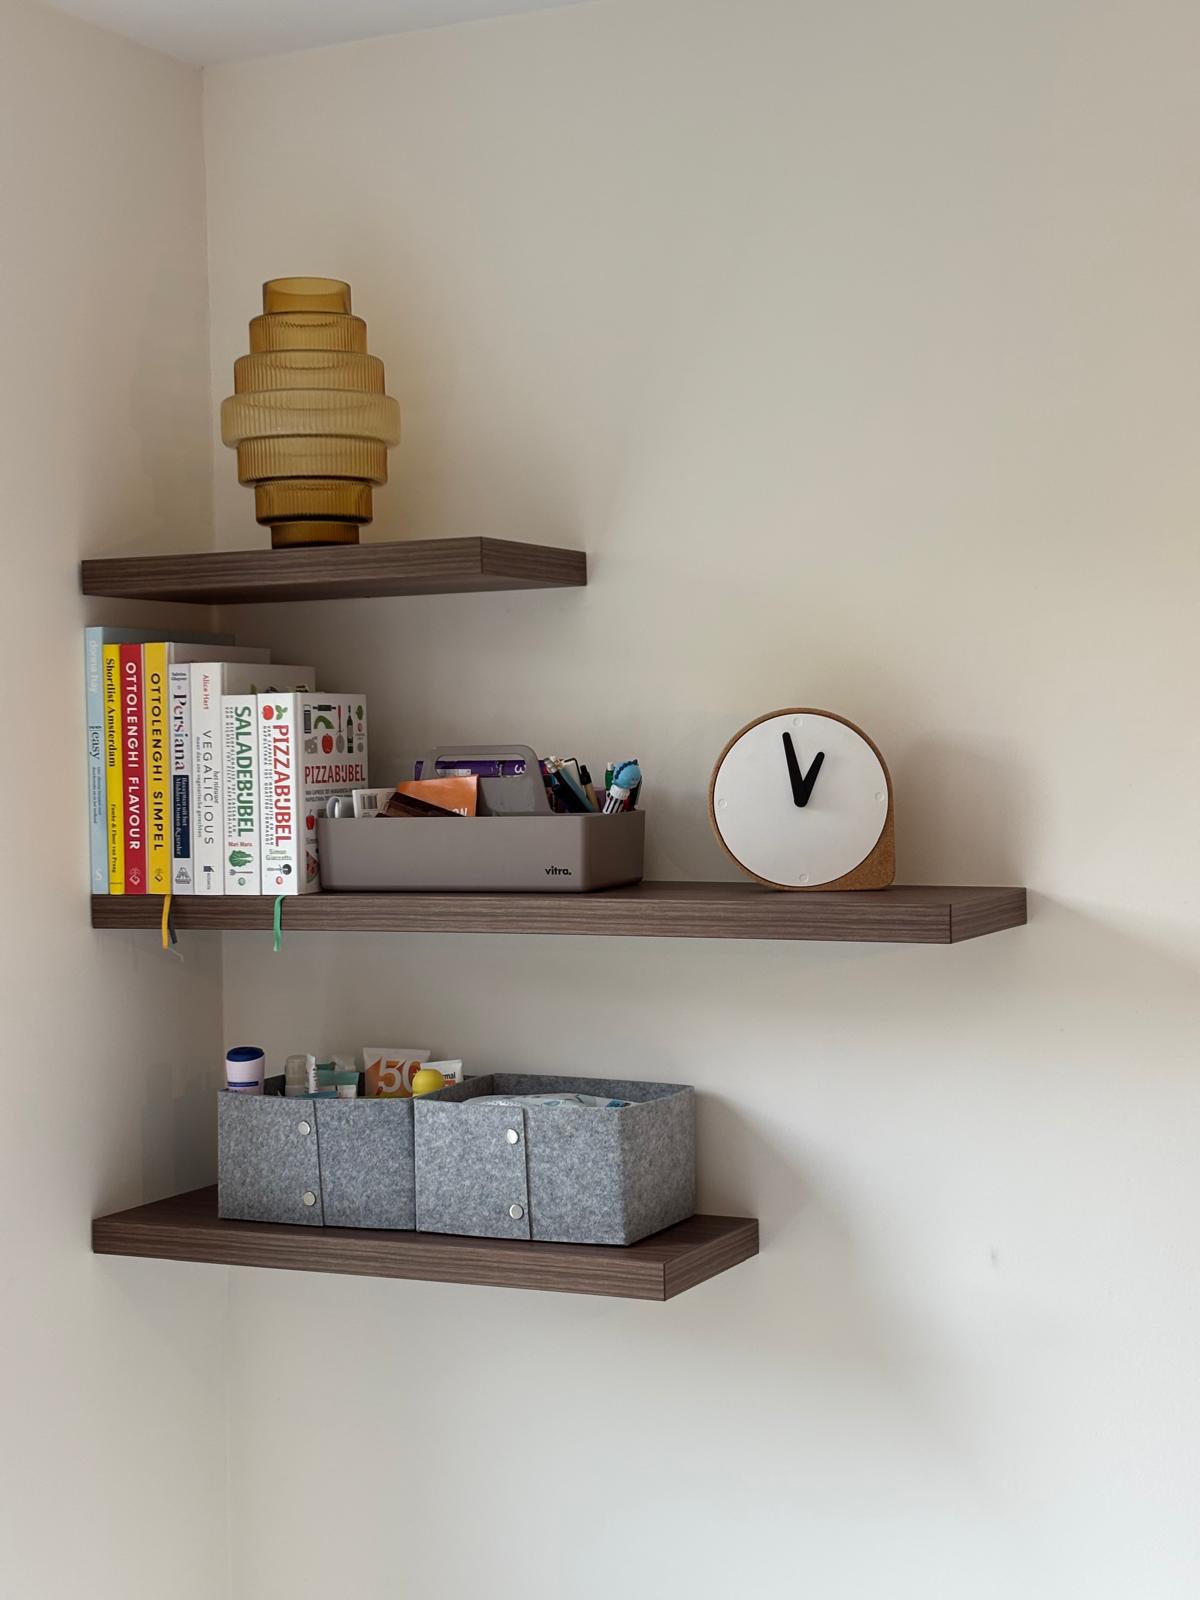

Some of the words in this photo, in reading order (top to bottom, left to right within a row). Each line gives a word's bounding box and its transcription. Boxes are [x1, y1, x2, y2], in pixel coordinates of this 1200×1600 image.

[88, 675, 98, 693] hay
[106, 658, 116, 703] Shortlist
[107, 706, 117, 767] Amsterdam
[126, 662, 139, 768] OTTOLENGHI
[151, 673, 163, 781] OTTOLENGHI
[173, 694, 188, 771] Persiana
[90, 732, 100, 760] easy
[128, 777, 140, 850] FLAVOUR
[203, 730, 214, 845] VEGALICIOUS
[154, 791, 163, 851] SIMPEL
[544, 866, 572, 876] vitra.
